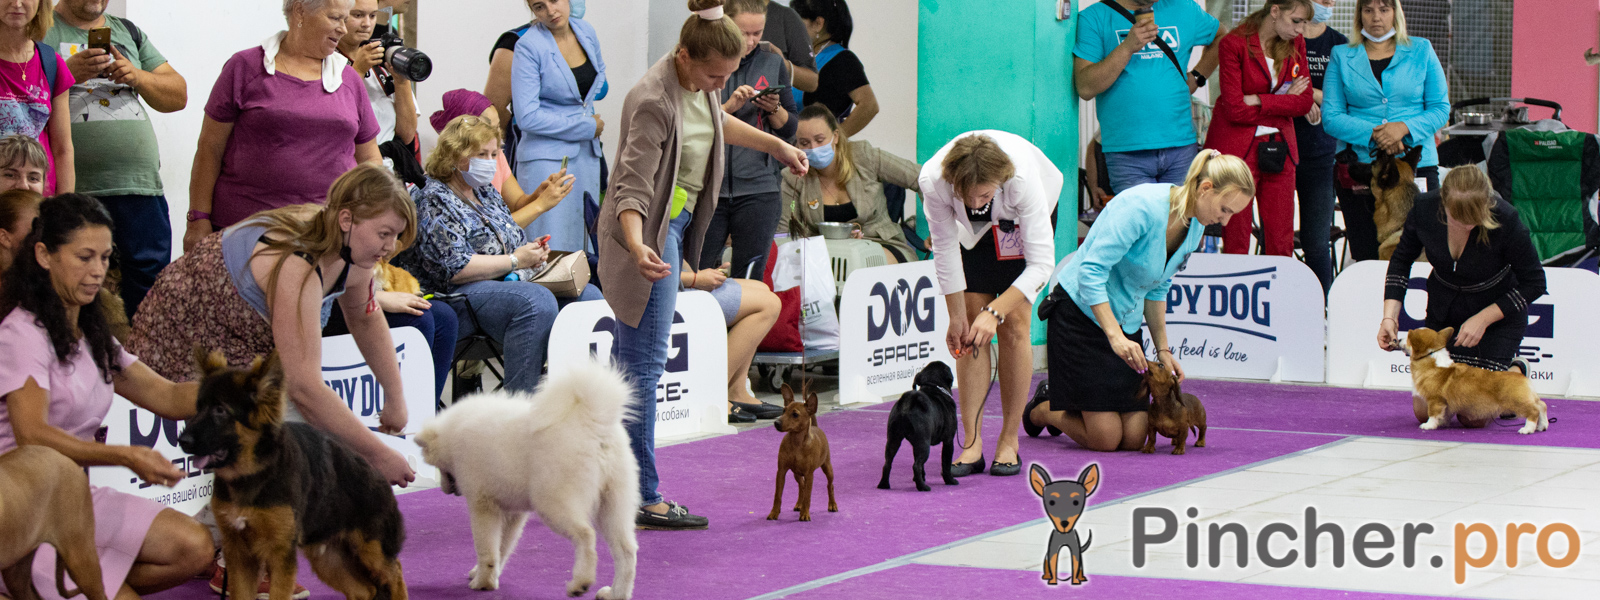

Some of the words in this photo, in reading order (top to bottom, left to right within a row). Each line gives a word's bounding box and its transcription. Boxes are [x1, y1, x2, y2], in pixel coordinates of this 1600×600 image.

[1306, 55, 1331, 63] rombi
[1000, 231, 1021, 250] 138
[867, 276, 936, 342] DOG
[1165, 284, 1204, 315] PY
[1208, 280, 1271, 328] DOG
[1179, 337, 1208, 361] feed
[1208, 346, 1221, 359] is
[1223, 342, 1249, 362] love
[1390, 364, 1411, 373] все
[1530, 370, 1554, 380] аки
[661, 406, 690, 421] собаки
[172, 484, 198, 505] вашей
[198, 480, 213, 498] соб
